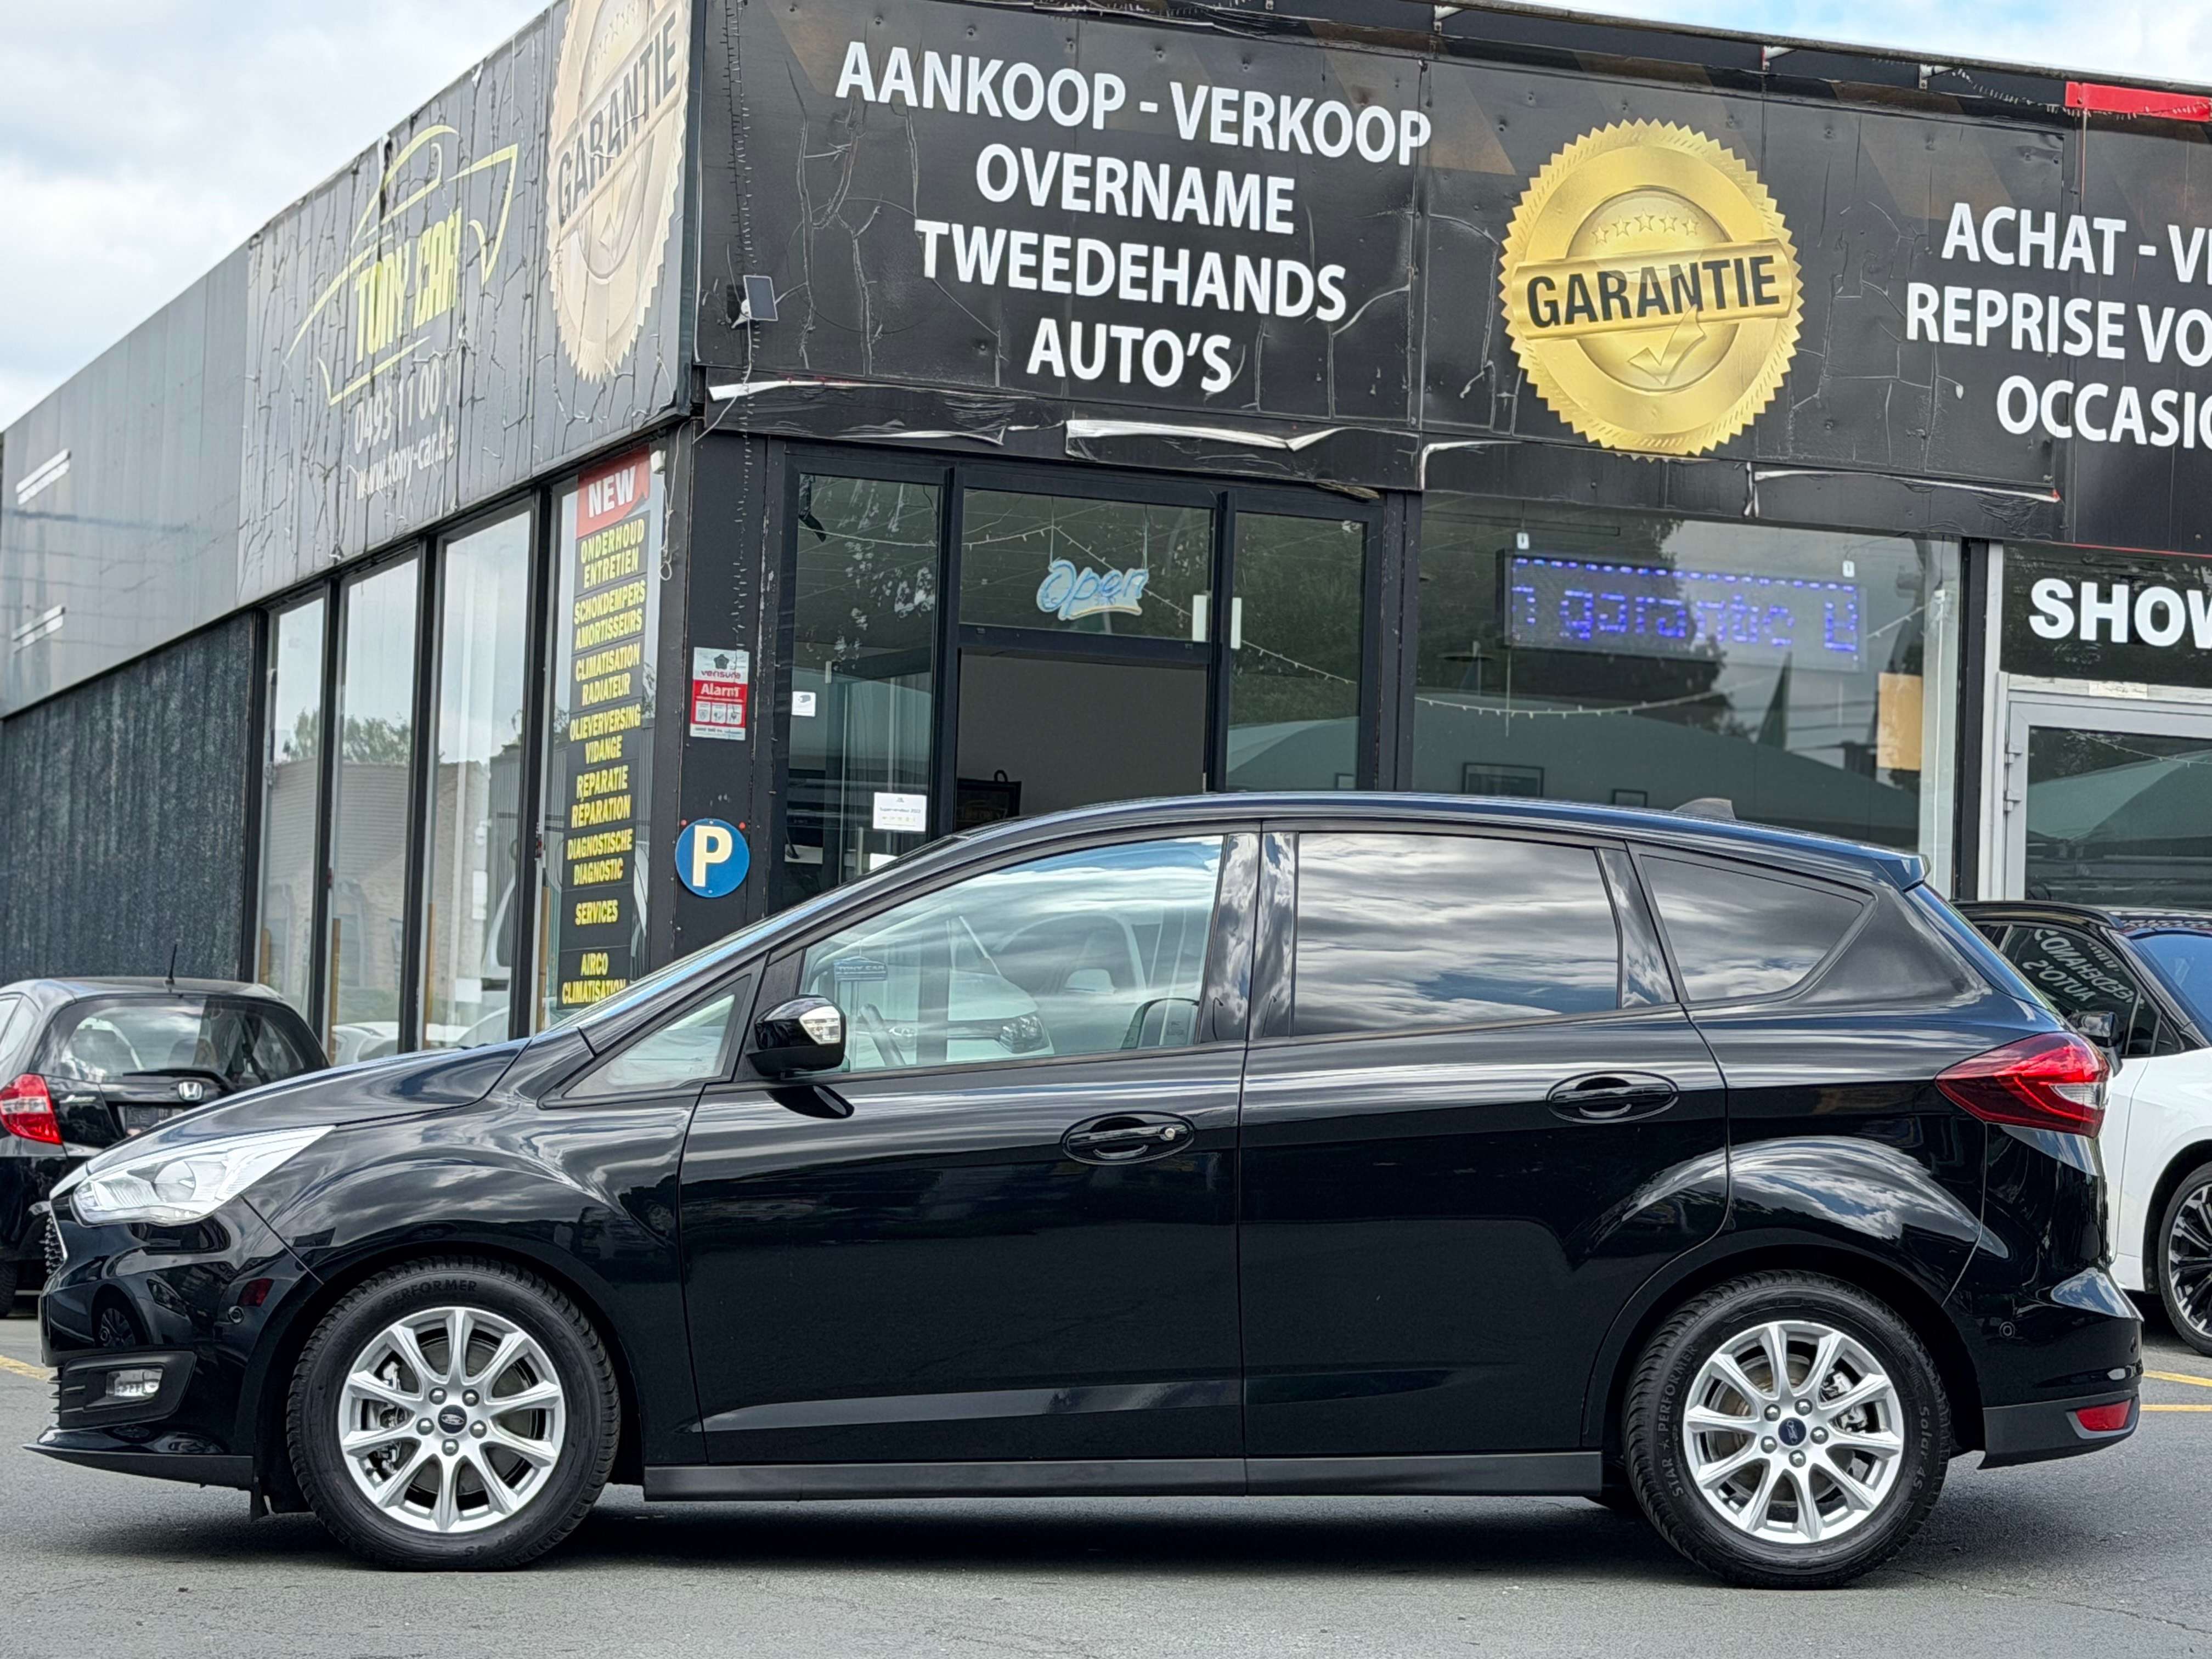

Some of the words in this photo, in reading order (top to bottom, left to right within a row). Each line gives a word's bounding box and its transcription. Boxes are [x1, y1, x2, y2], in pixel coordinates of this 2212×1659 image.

[557, 11, 677, 225] GARANTIE
[835, 41, 1126, 129] AANKOOP
[1139, 101, 1158, 113] -
[1170, 82, 1431, 166] VERKOOP
[976, 143, 1295, 234] OVERNAME
[1941, 202, 2126, 275] ACHAT
[2138, 245, 2157, 256] -
[2167, 224, 2212, 285] V
[914, 218, 1347, 323] TWEEDEHANDS
[1526, 254, 1780, 329] GARANTIE
[354, 240, 410, 363] TONY
[1906, 281, 2125, 360] REPRISE
[2137, 304, 2212, 367] VO
[1026, 318, 1233, 392] AUTO'S
[354, 383, 393, 454] 0493
[419, 358, 439, 421] 00
[588, 465, 636, 518] NEW
[580, 518, 645, 564] ONDERHOUD
[583, 546, 639, 589] ENTRETIEN
[1036, 560, 1149, 621] Open
[574, 579, 646, 625] SCHOKDEMPERS
[574, 607, 643, 650] AMORTISSEURS
[575, 642, 641, 682] CLIMATISATION
[582, 672, 631, 707] RADIATEUR
[701, 682, 741, 697] Alarm
[569, 703, 641, 742] OLIEVERVERSING
[585, 735, 623, 764] VIDANGE
[576, 765, 629, 799] REPARATIE
[567, 828, 633, 860] DIAGNOSTISCHE
[692, 825, 733, 887] P
[573, 857, 624, 885] DIAGNOSTIC
[575, 899, 619, 926] SERVICES
[580, 952, 609, 977] AIRCO
[383, 1279, 477, 1306] PERFORMER
[1657, 1344, 1699, 1432] PERFORMER
[1662, 1457, 1684, 1497] STAR
